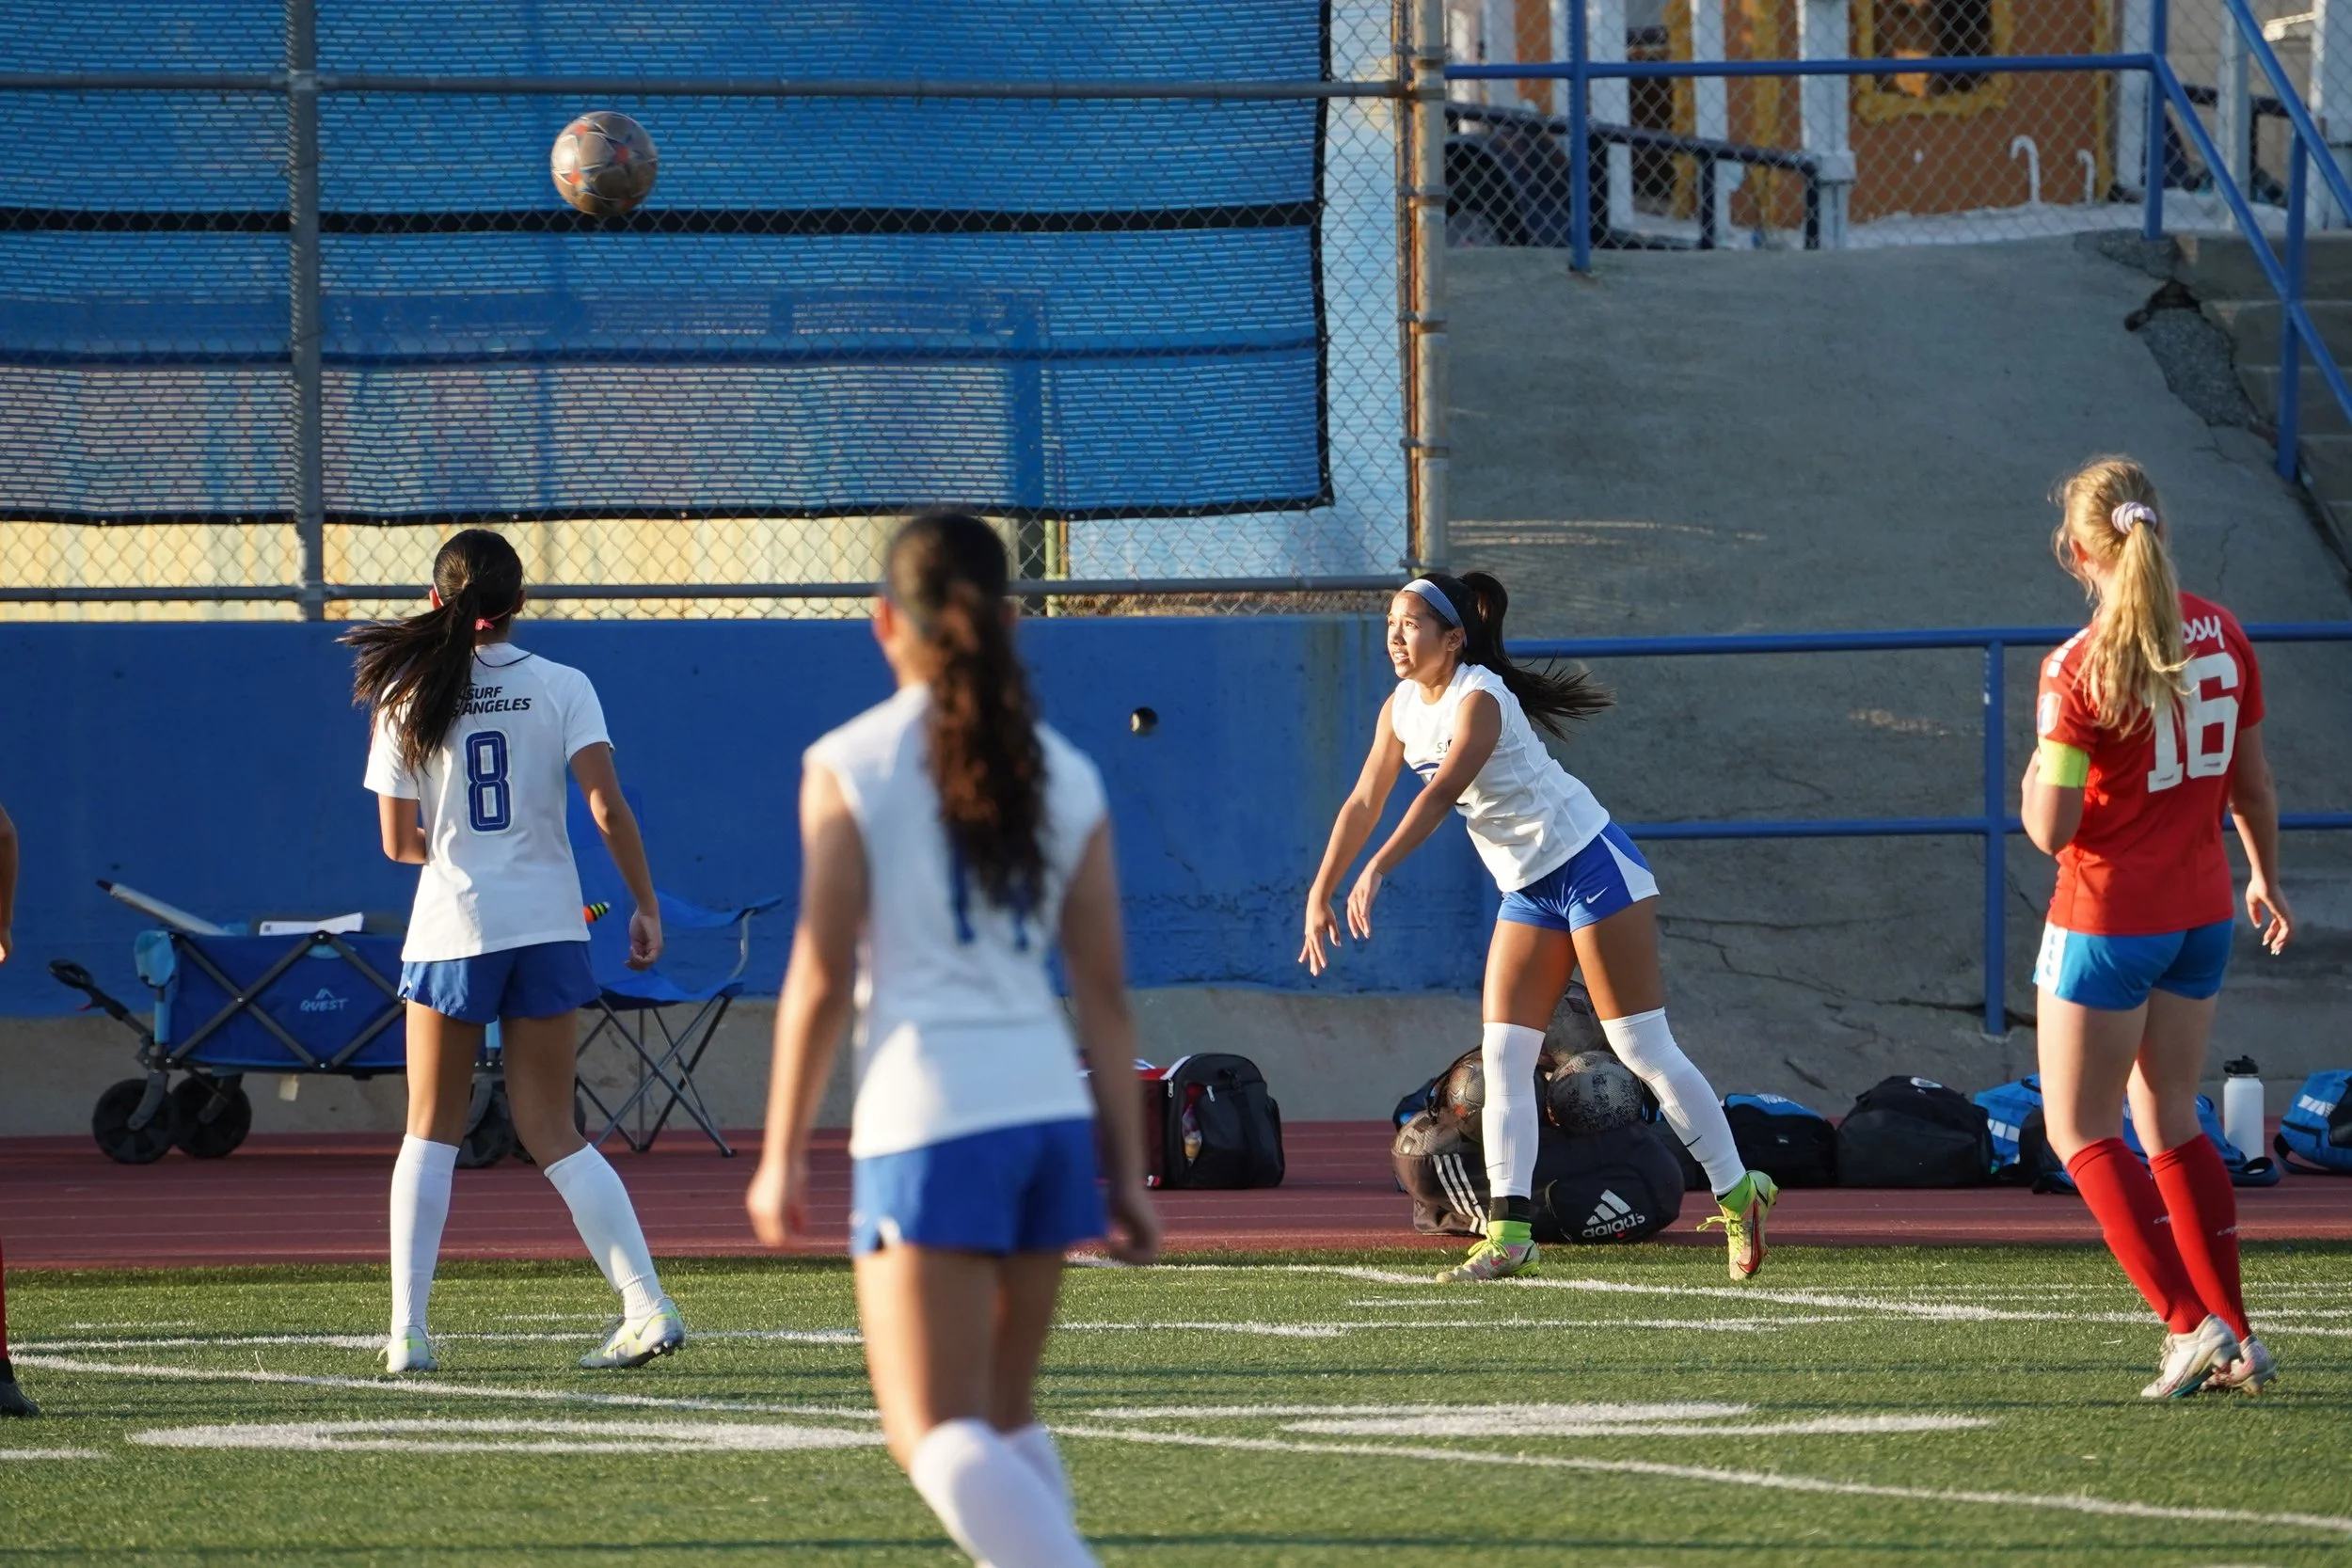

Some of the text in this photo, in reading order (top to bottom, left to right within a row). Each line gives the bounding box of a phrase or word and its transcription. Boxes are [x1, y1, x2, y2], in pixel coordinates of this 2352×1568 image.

[467, 687, 502, 701] SURF
[461, 698, 532, 716] ANGELES
[2142, 652, 2239, 793] 16
[465, 730, 512, 833] 8
[300, 997, 349, 1013] QUEST
